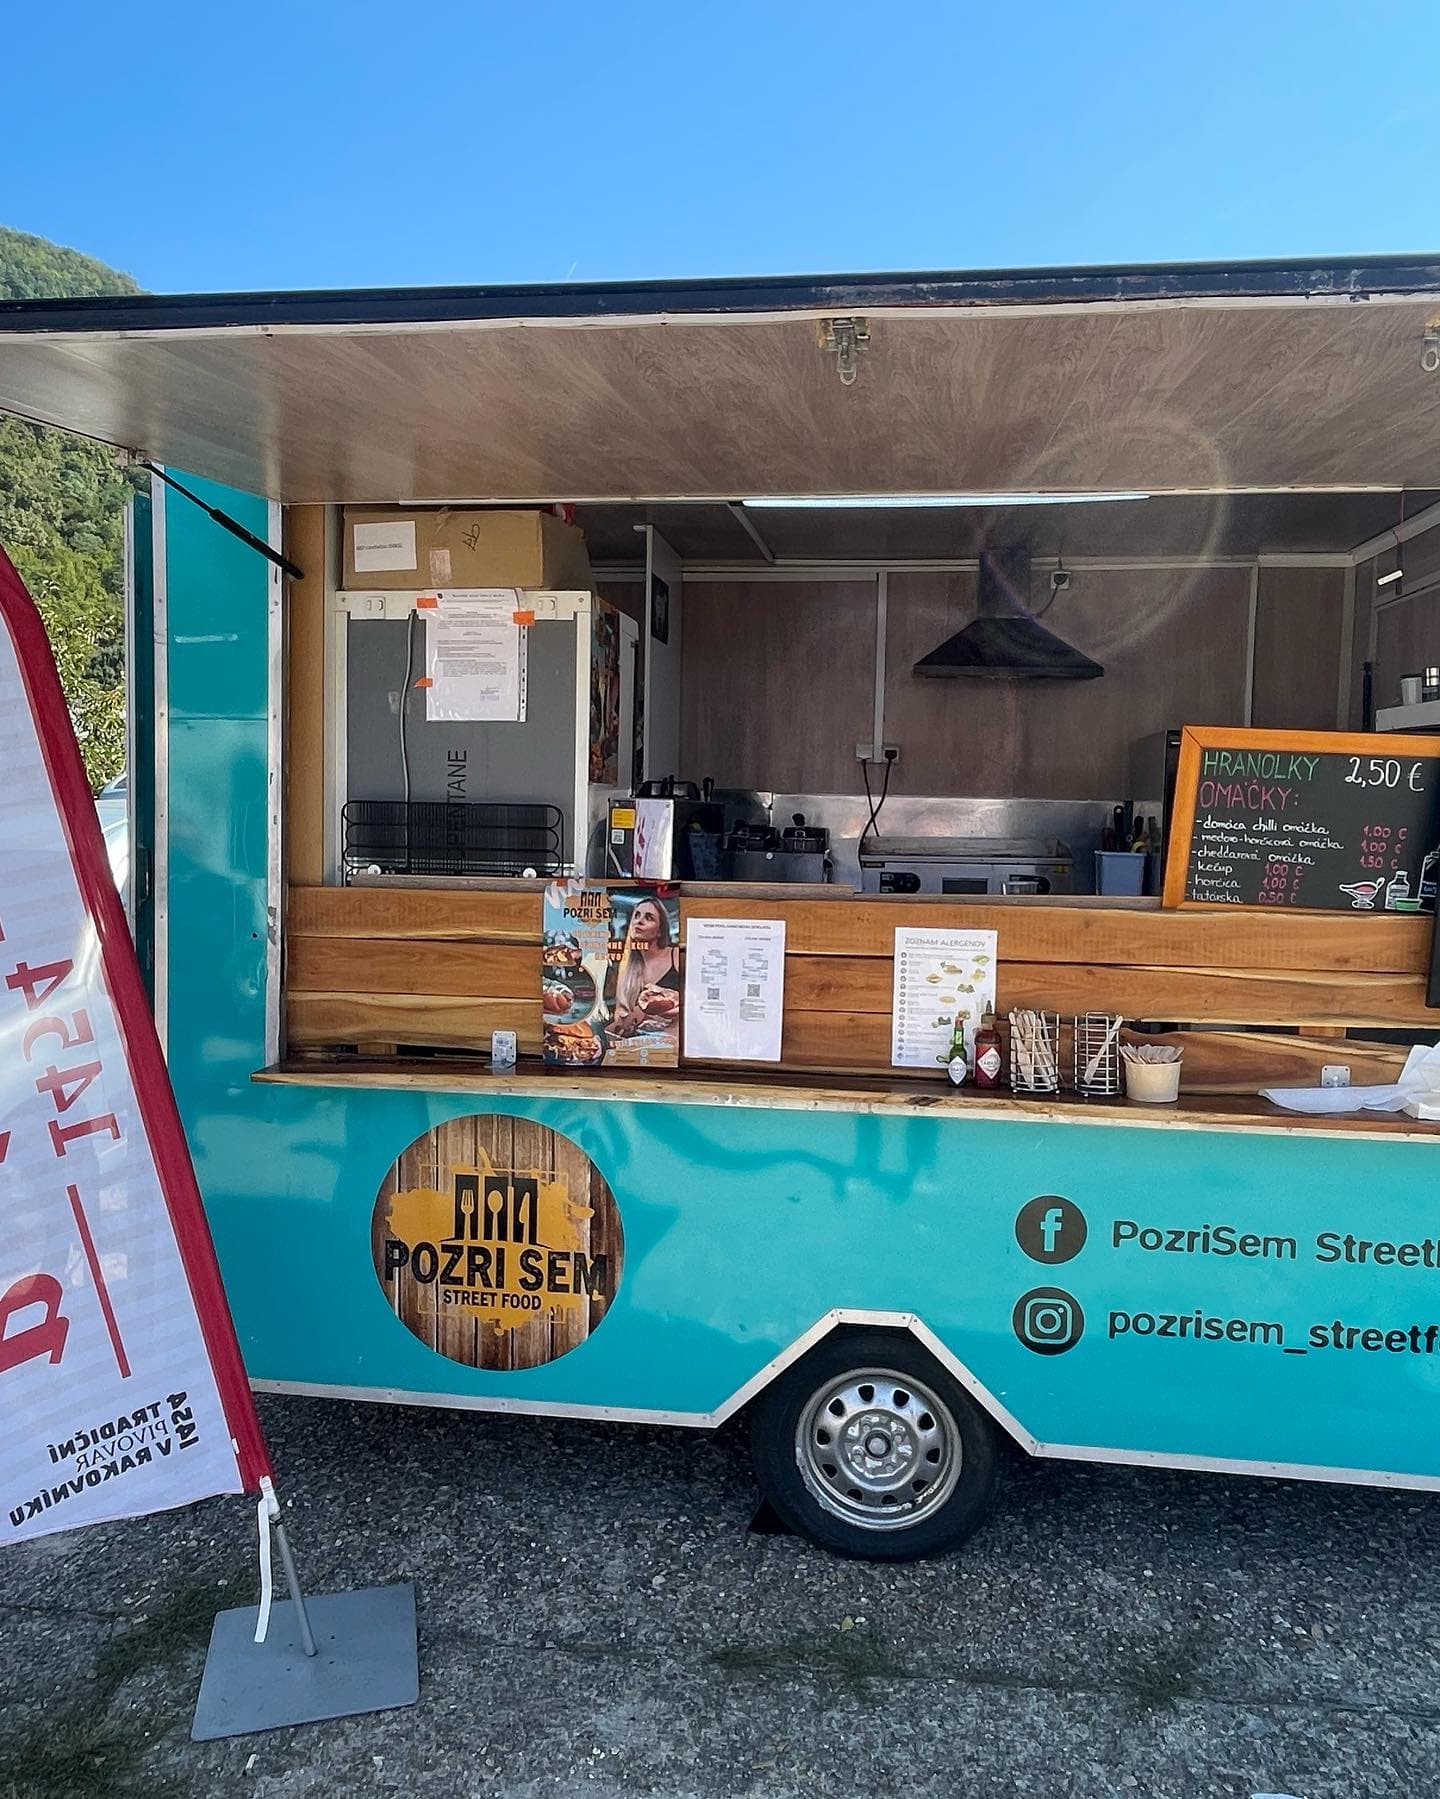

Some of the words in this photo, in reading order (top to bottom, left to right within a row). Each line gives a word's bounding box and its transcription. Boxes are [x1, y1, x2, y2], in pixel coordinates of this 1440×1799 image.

[1203, 751, 1319, 781] HRANOLKY
[1344, 756, 1401, 788] 2,50
[1252, 816, 1277, 832] chilli
[1282, 821, 1330, 835] omáčka
[563, 907, 593, 919] POZRI
[904, 937, 939, 946] ZOZNAM
[1112, 1220, 1297, 1260] PozriSem
[1315, 1232, 1440, 1269] Street
[384, 1239, 506, 1289] POZRI
[518, 1248, 608, 1297] SEM
[443, 1289, 498, 1308] STREET
[501, 1293, 542, 1311] FOOD
